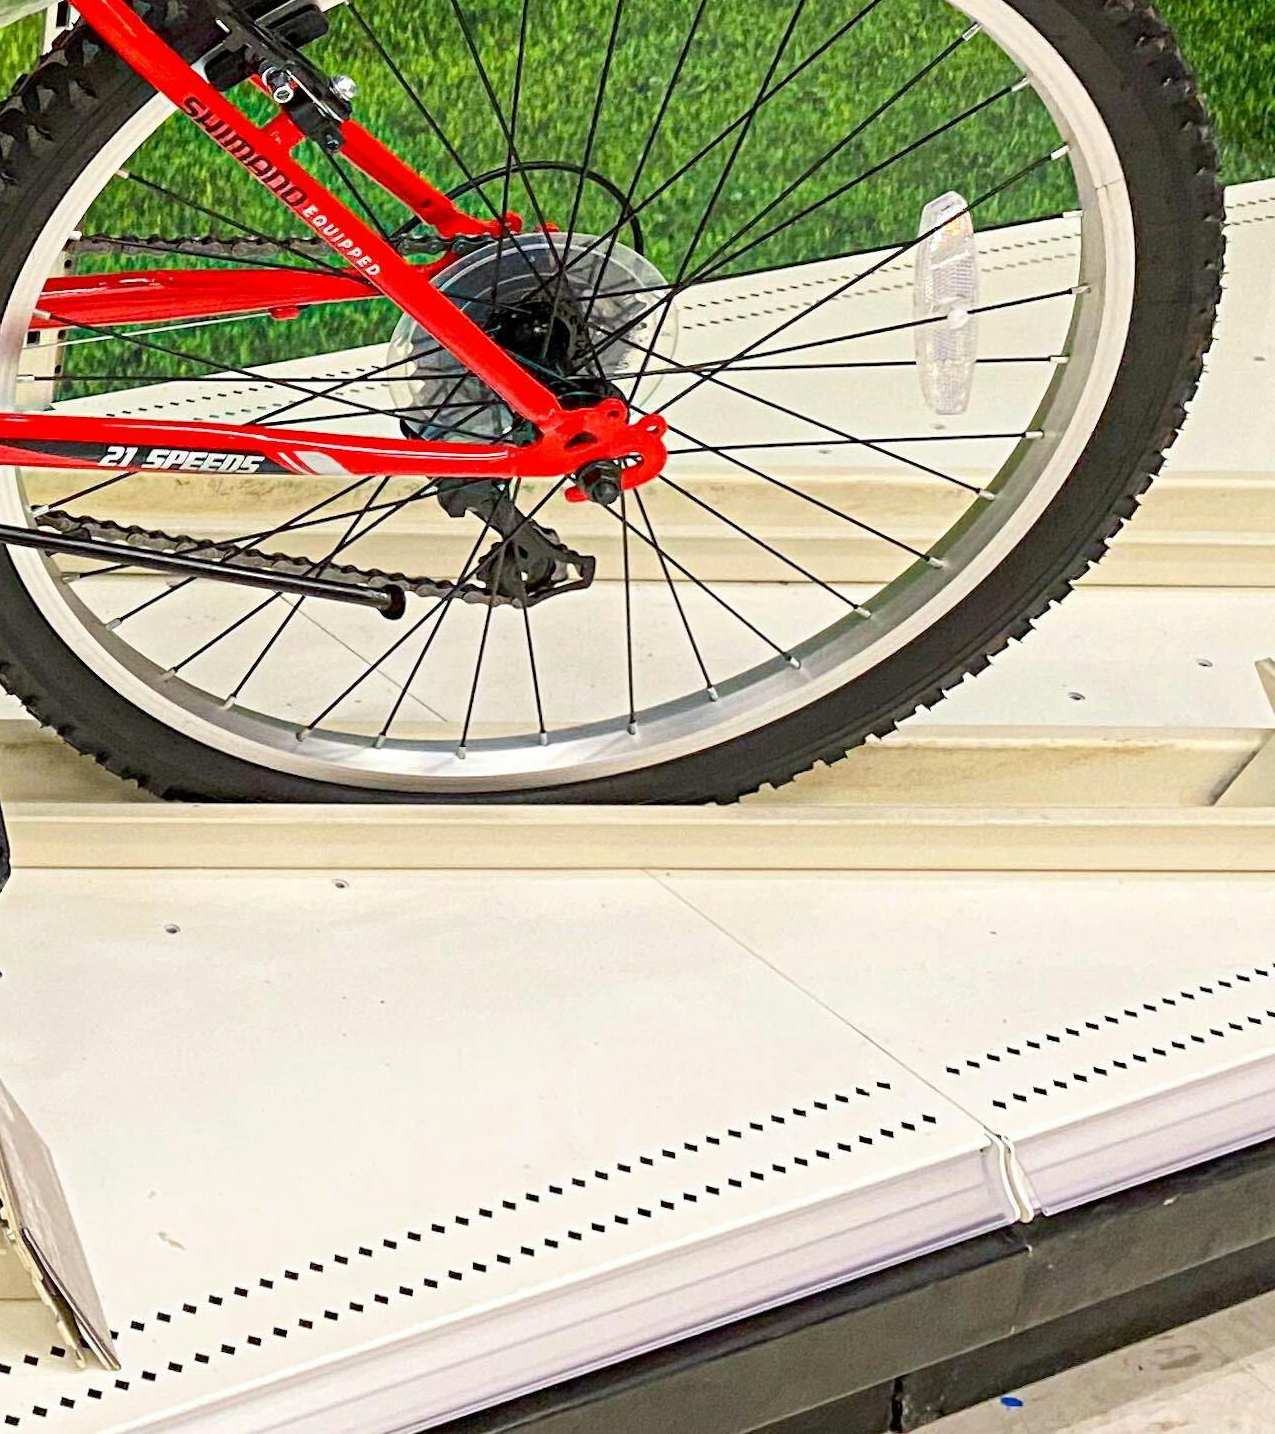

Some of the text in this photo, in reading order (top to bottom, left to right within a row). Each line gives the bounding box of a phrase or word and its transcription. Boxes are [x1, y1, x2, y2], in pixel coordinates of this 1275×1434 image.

[181, 96, 309, 207] SHIMANO
[302, 204, 381, 277] EQUIPPED
[99, 445, 265, 473] 21 SPEEDS
